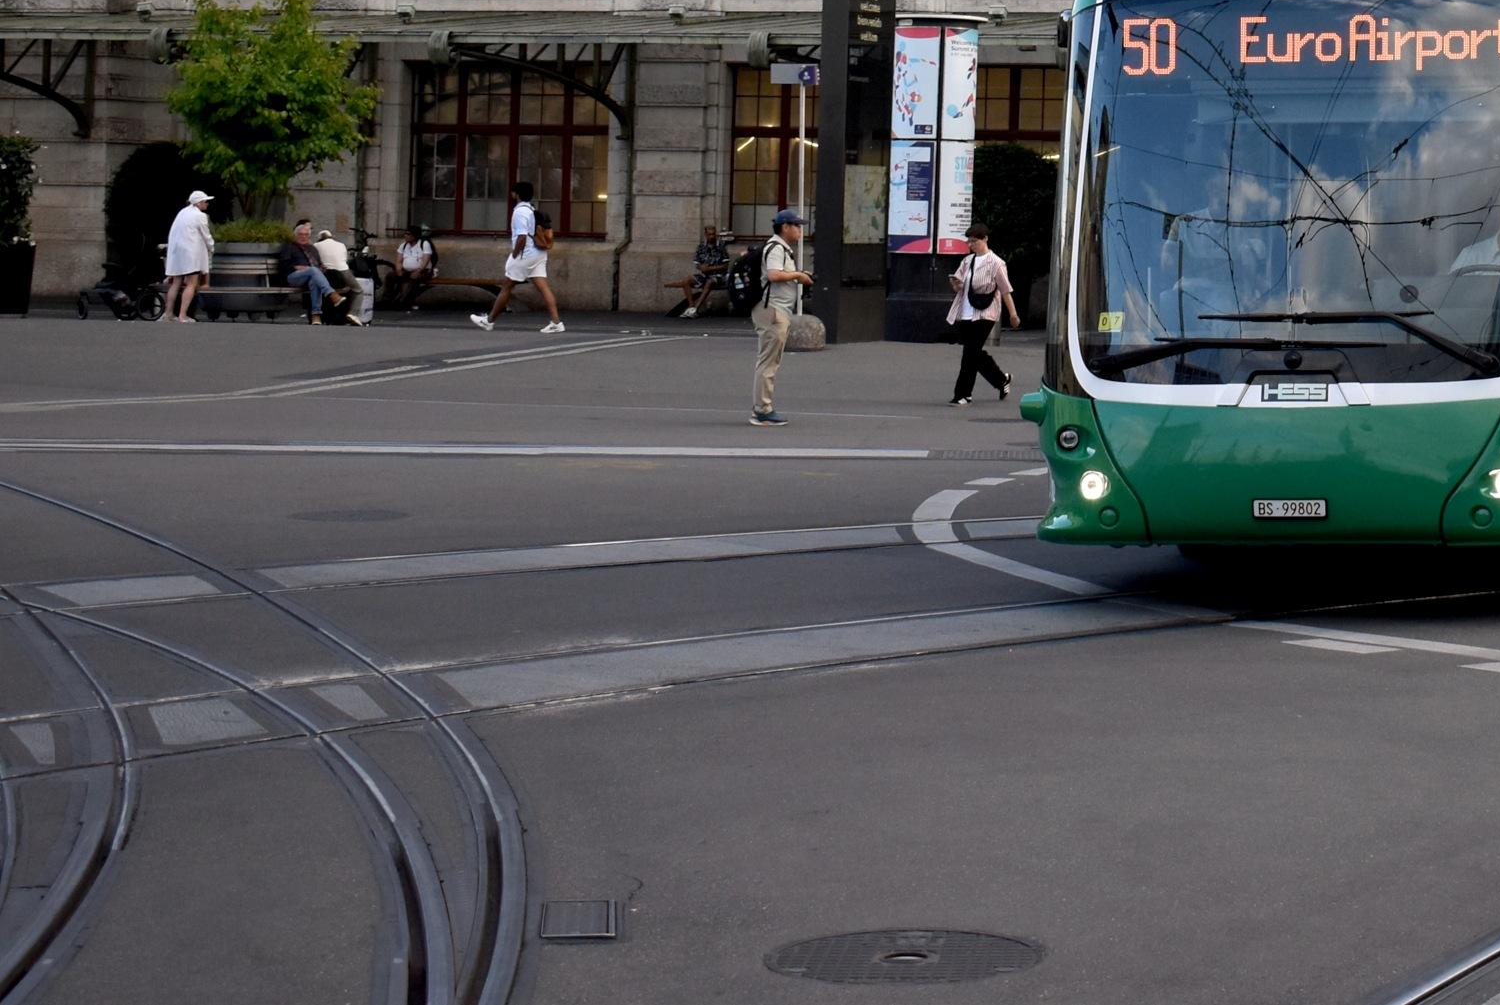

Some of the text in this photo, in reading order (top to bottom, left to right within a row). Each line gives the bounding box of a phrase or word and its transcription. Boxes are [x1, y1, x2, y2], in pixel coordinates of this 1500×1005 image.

[1123, 18, 1176, 76] 50
[1263, 383, 1328, 401] HESS
[1258, 502, 1321, 515] BS 99802
